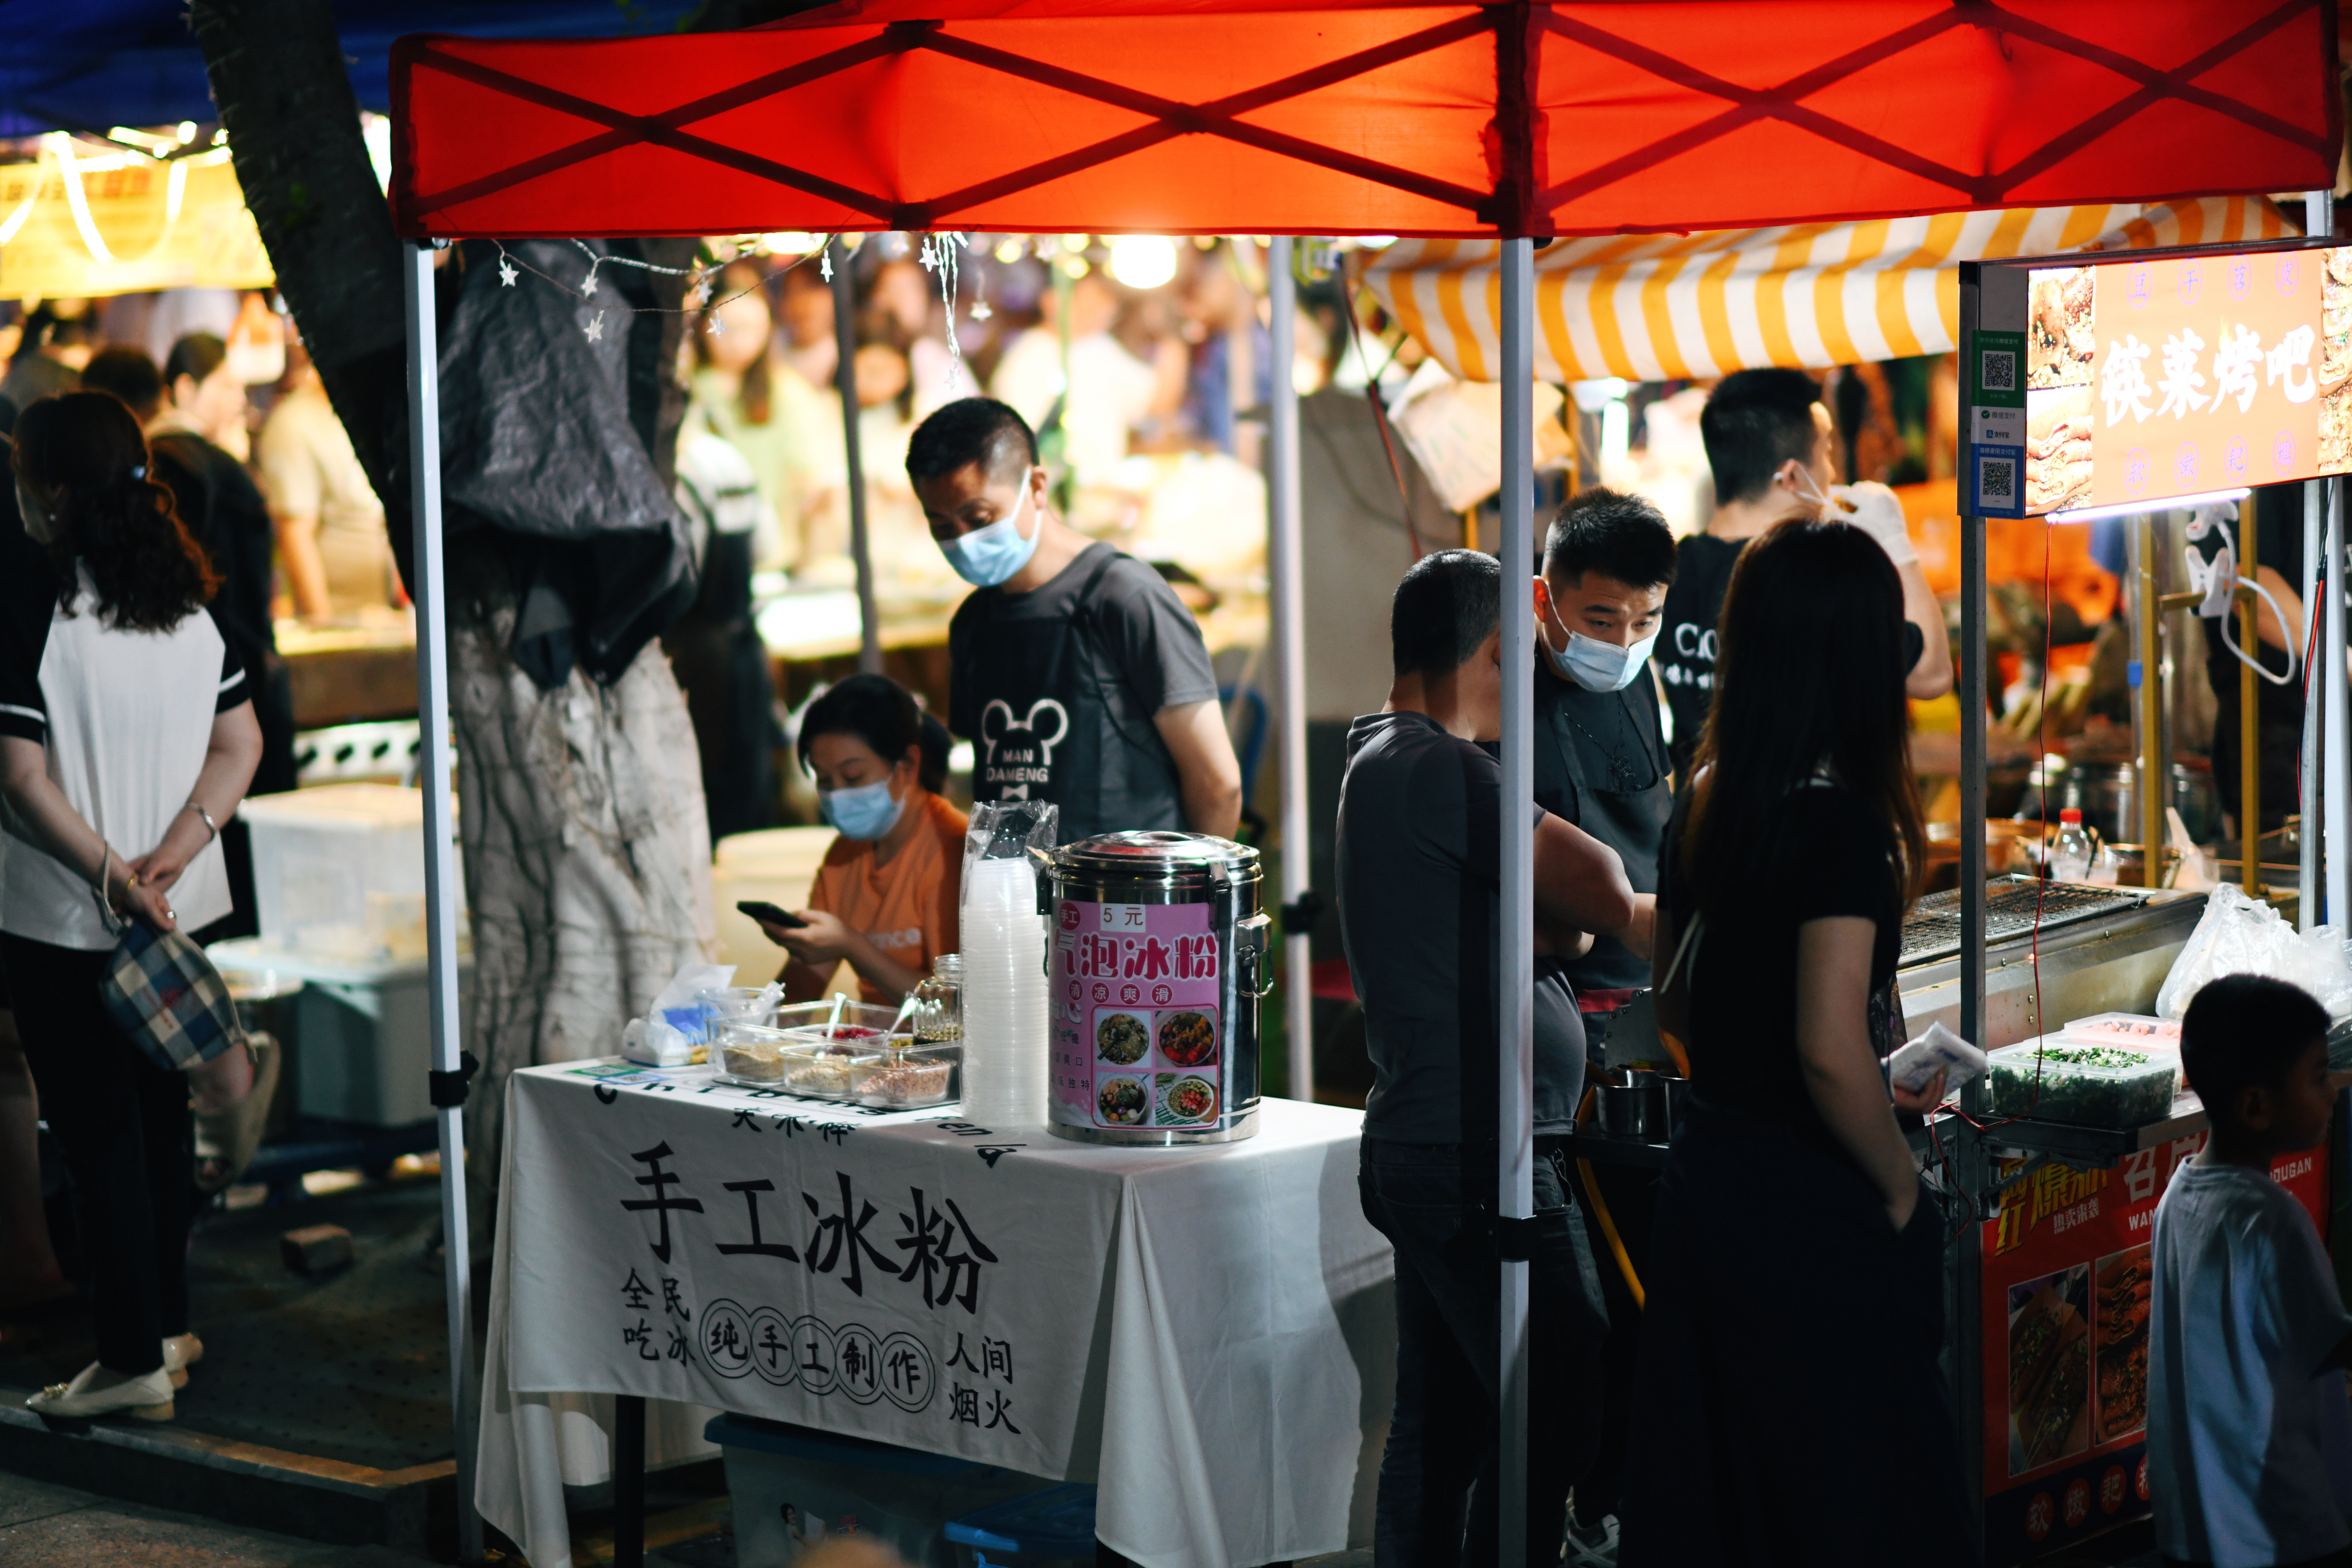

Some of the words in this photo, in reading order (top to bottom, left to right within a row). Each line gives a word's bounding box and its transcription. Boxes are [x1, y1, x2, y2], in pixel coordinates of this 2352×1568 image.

[2101, 323, 2316, 428] 筷菜烤吧
[1991, 411, 2015, 419] 微信支付
[1979, 447, 2016, 456] 推荐使用支付宝
[1003, 749, 1034, 762] MAN
[987, 768, 1048, 782] DAMENG
[1060, 909, 1078, 923] 手工
[1103, 908, 1113, 923] 5
[1124, 908, 1144, 927] 元
[1070, 984, 1172, 1002] 清凉爽滑
[620, 1140, 998, 1314] 手工冰粉
[2053, 1197, 2100, 1235] 热卖来袭
[620, 1267, 690, 1322] 全民
[622, 1318, 696, 1367] 吃冰
[711, 1317, 921, 1394] 纯手工制作
[946, 1332, 1014, 1384] 人间
[948, 1382, 1021, 1435] 烟火
